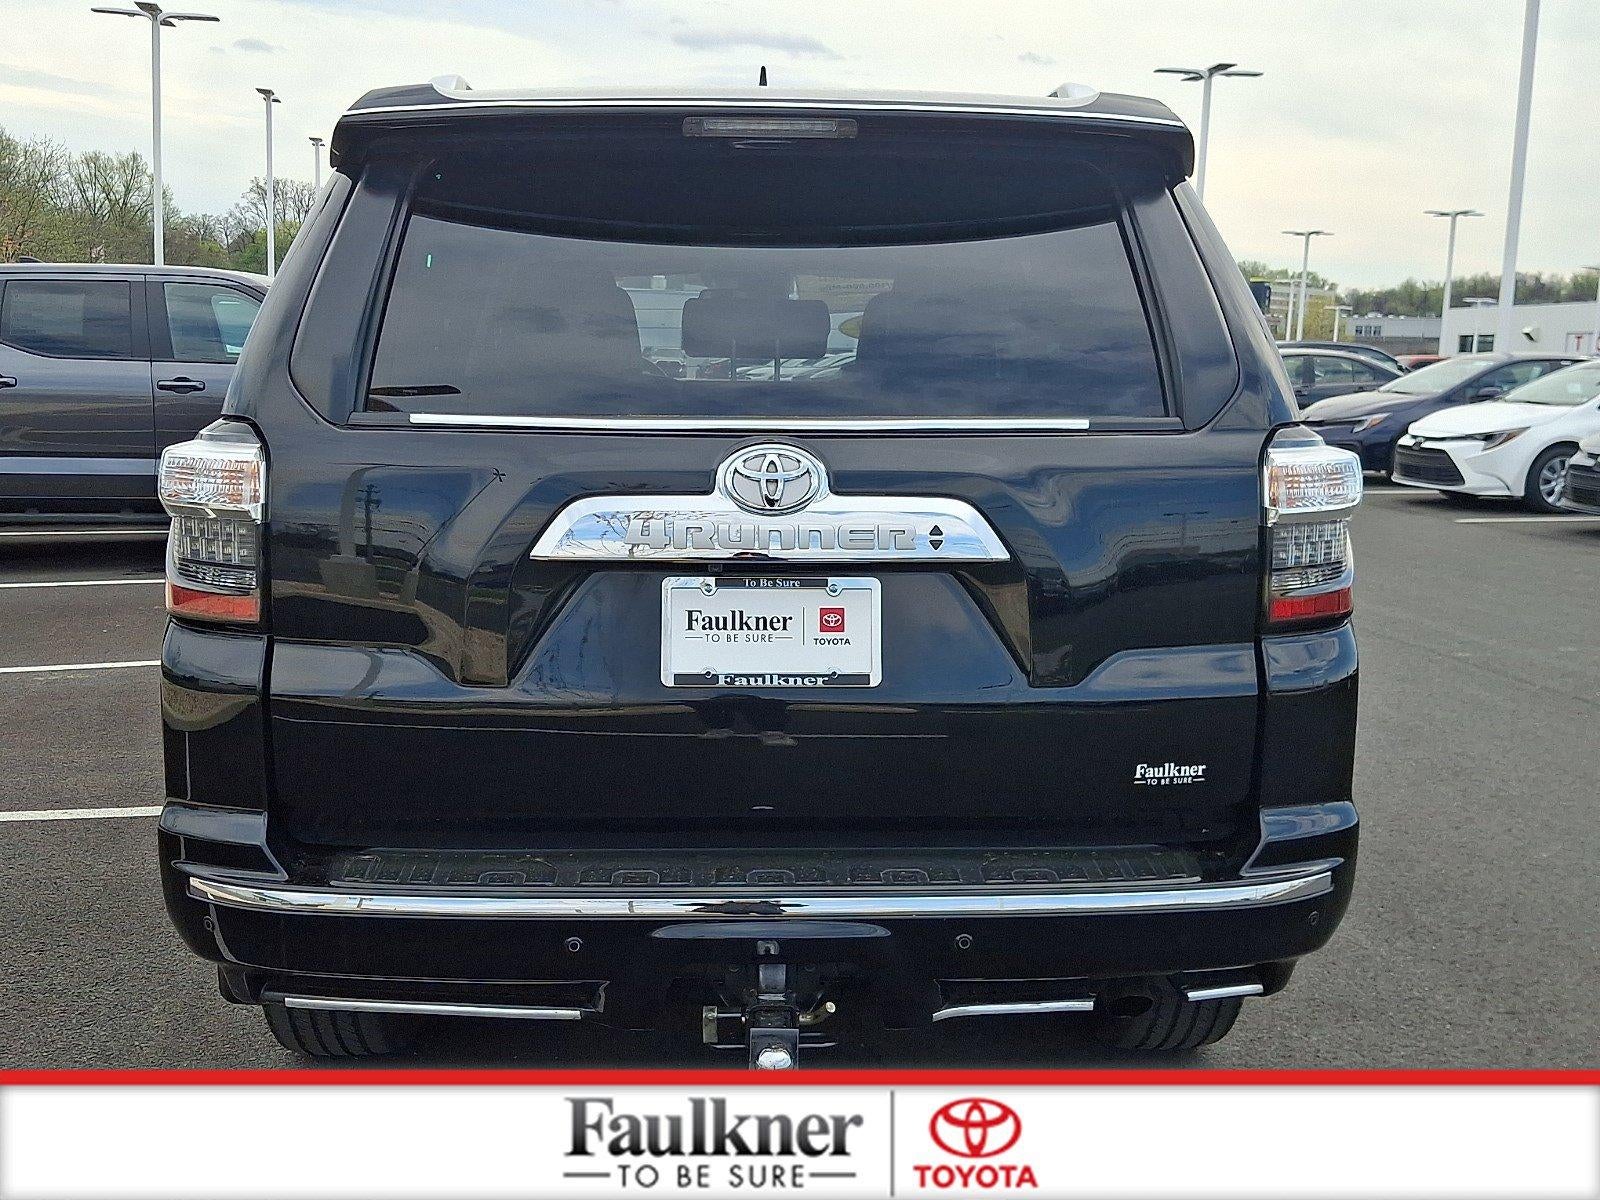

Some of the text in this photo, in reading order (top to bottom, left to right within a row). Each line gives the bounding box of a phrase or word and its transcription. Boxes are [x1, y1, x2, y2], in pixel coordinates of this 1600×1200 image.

[743, 579, 800, 587] To Be Sure
[685, 609, 793, 631] Faulkner
[705, 633, 774, 643] TO BE SURE
[813, 637, 851, 646] TOYOTA
[717, 674, 829, 686] Faulkner
[1134, 763, 1206, 778] Faulkner
